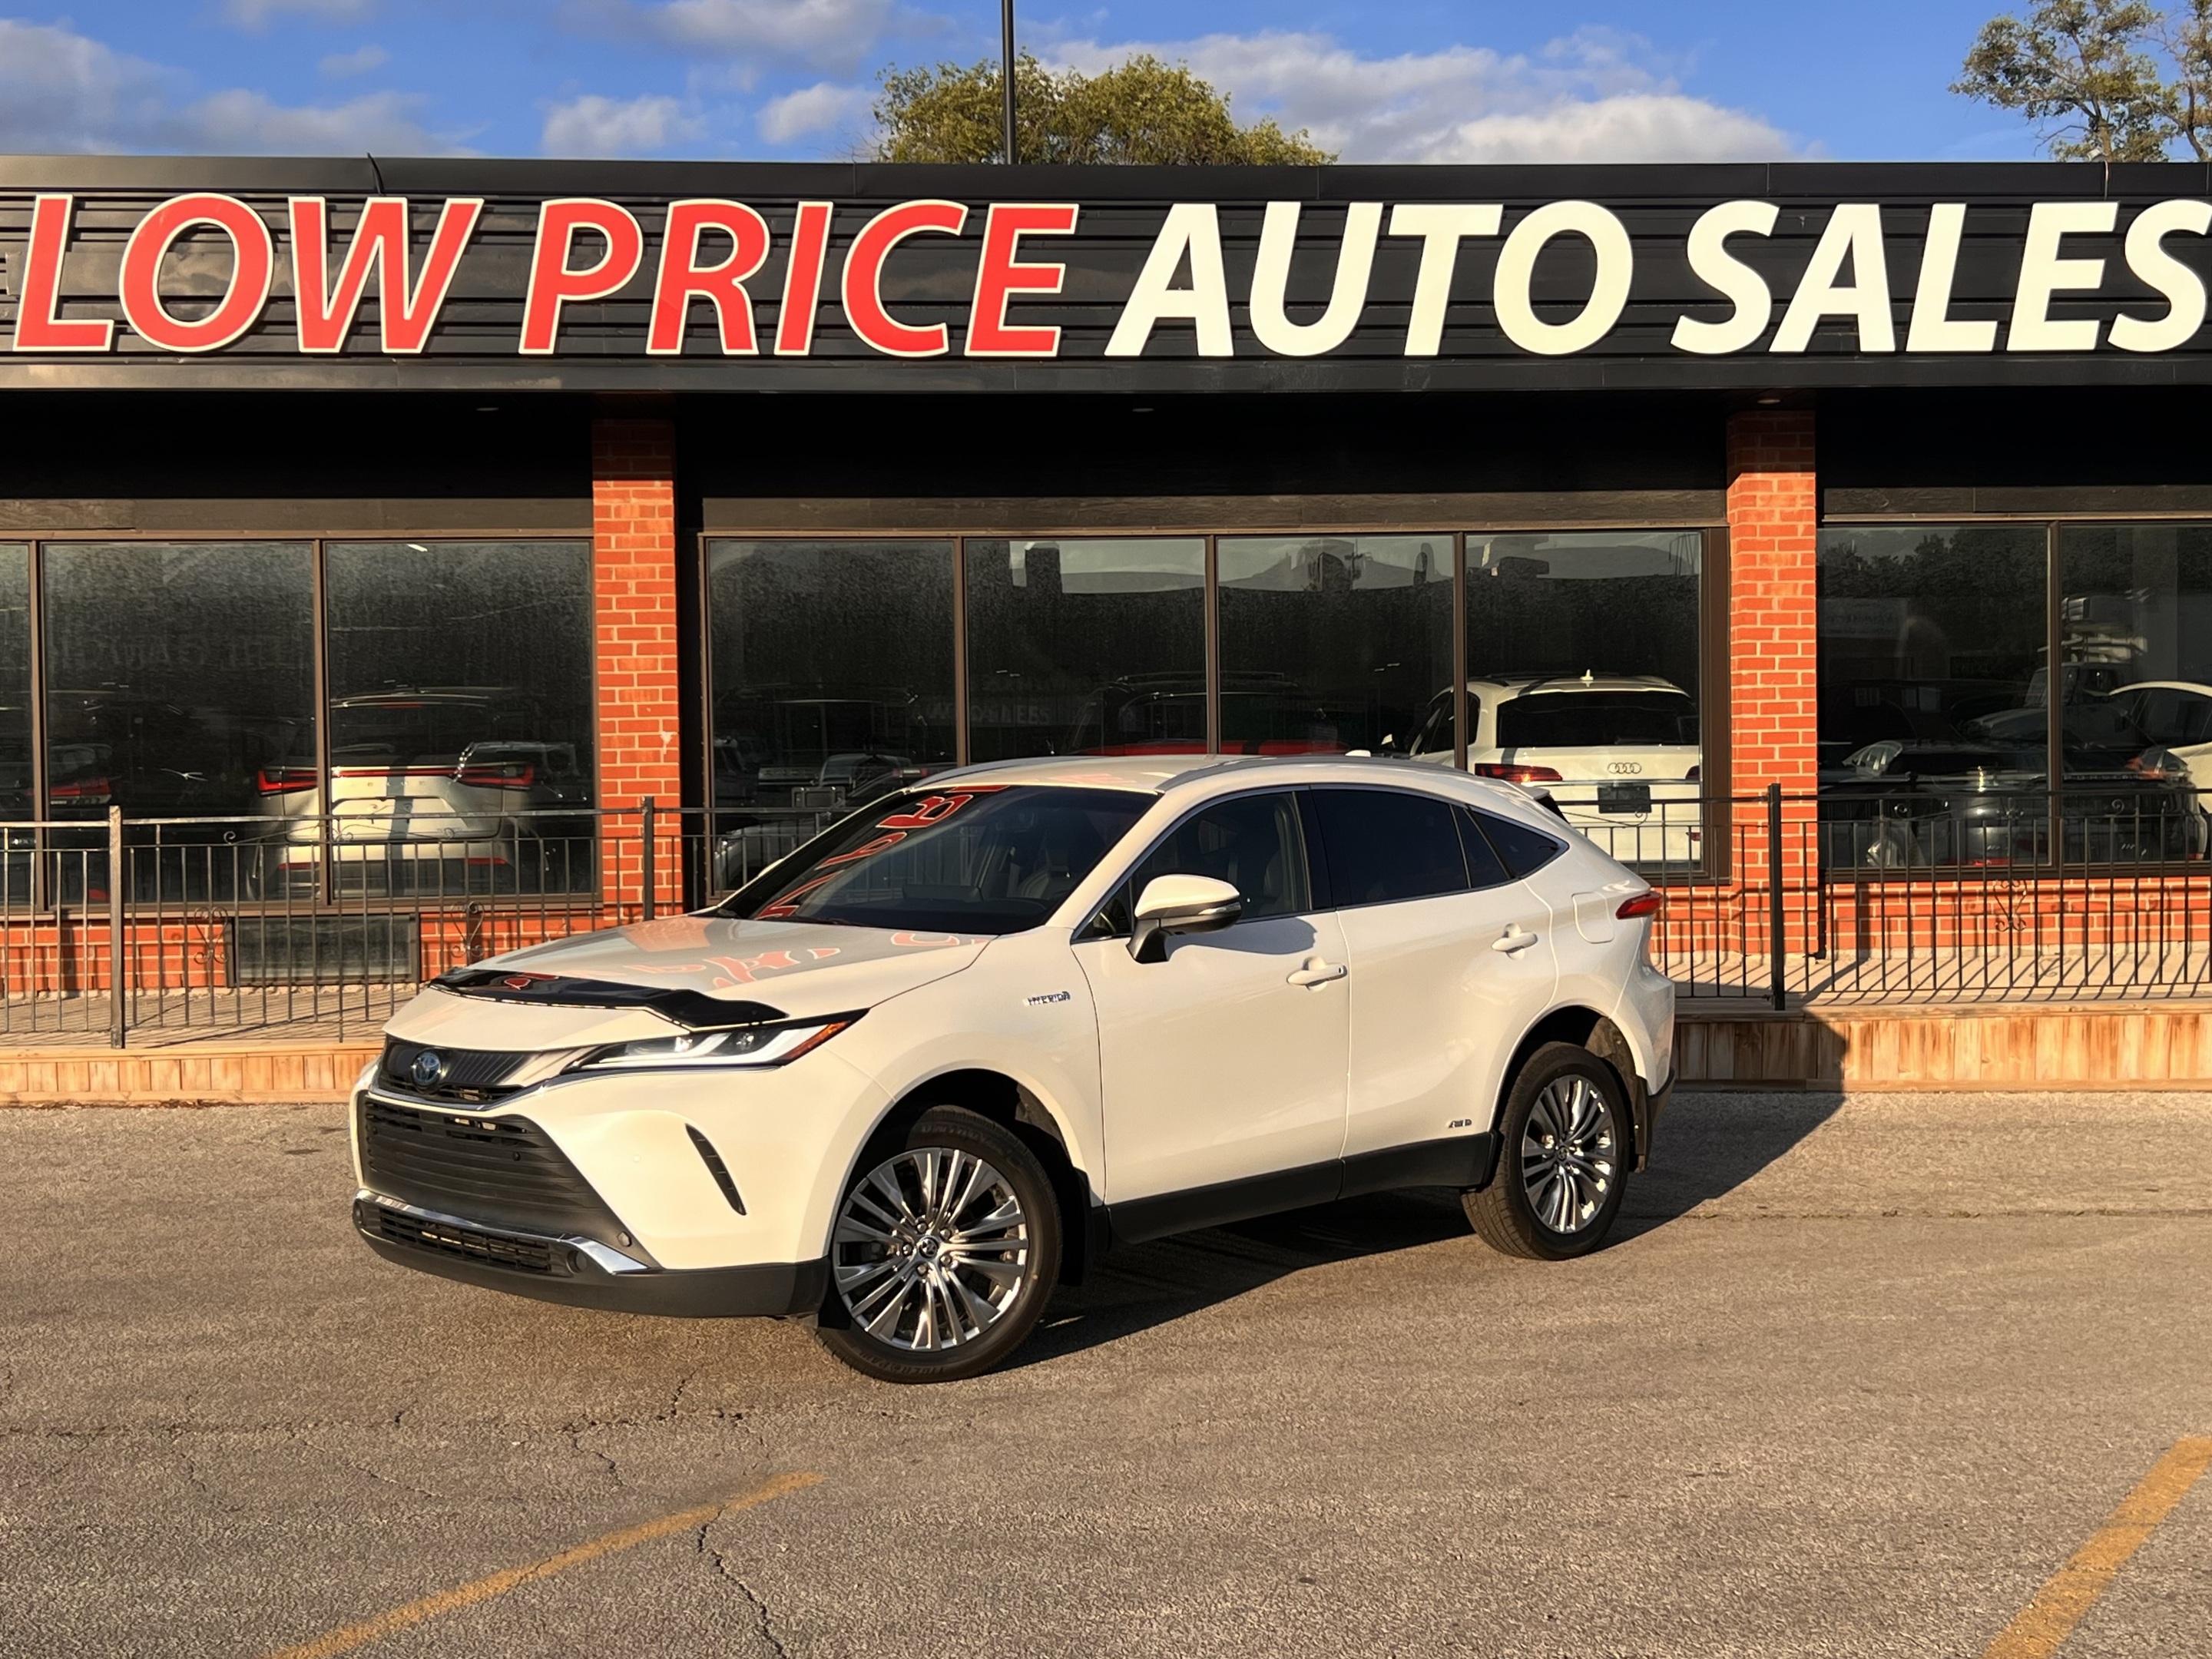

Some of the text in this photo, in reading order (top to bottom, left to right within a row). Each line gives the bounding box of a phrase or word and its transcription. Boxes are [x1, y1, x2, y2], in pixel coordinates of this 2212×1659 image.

[12, 192, 2212, 358] LOW PRICE AUTO SALES
